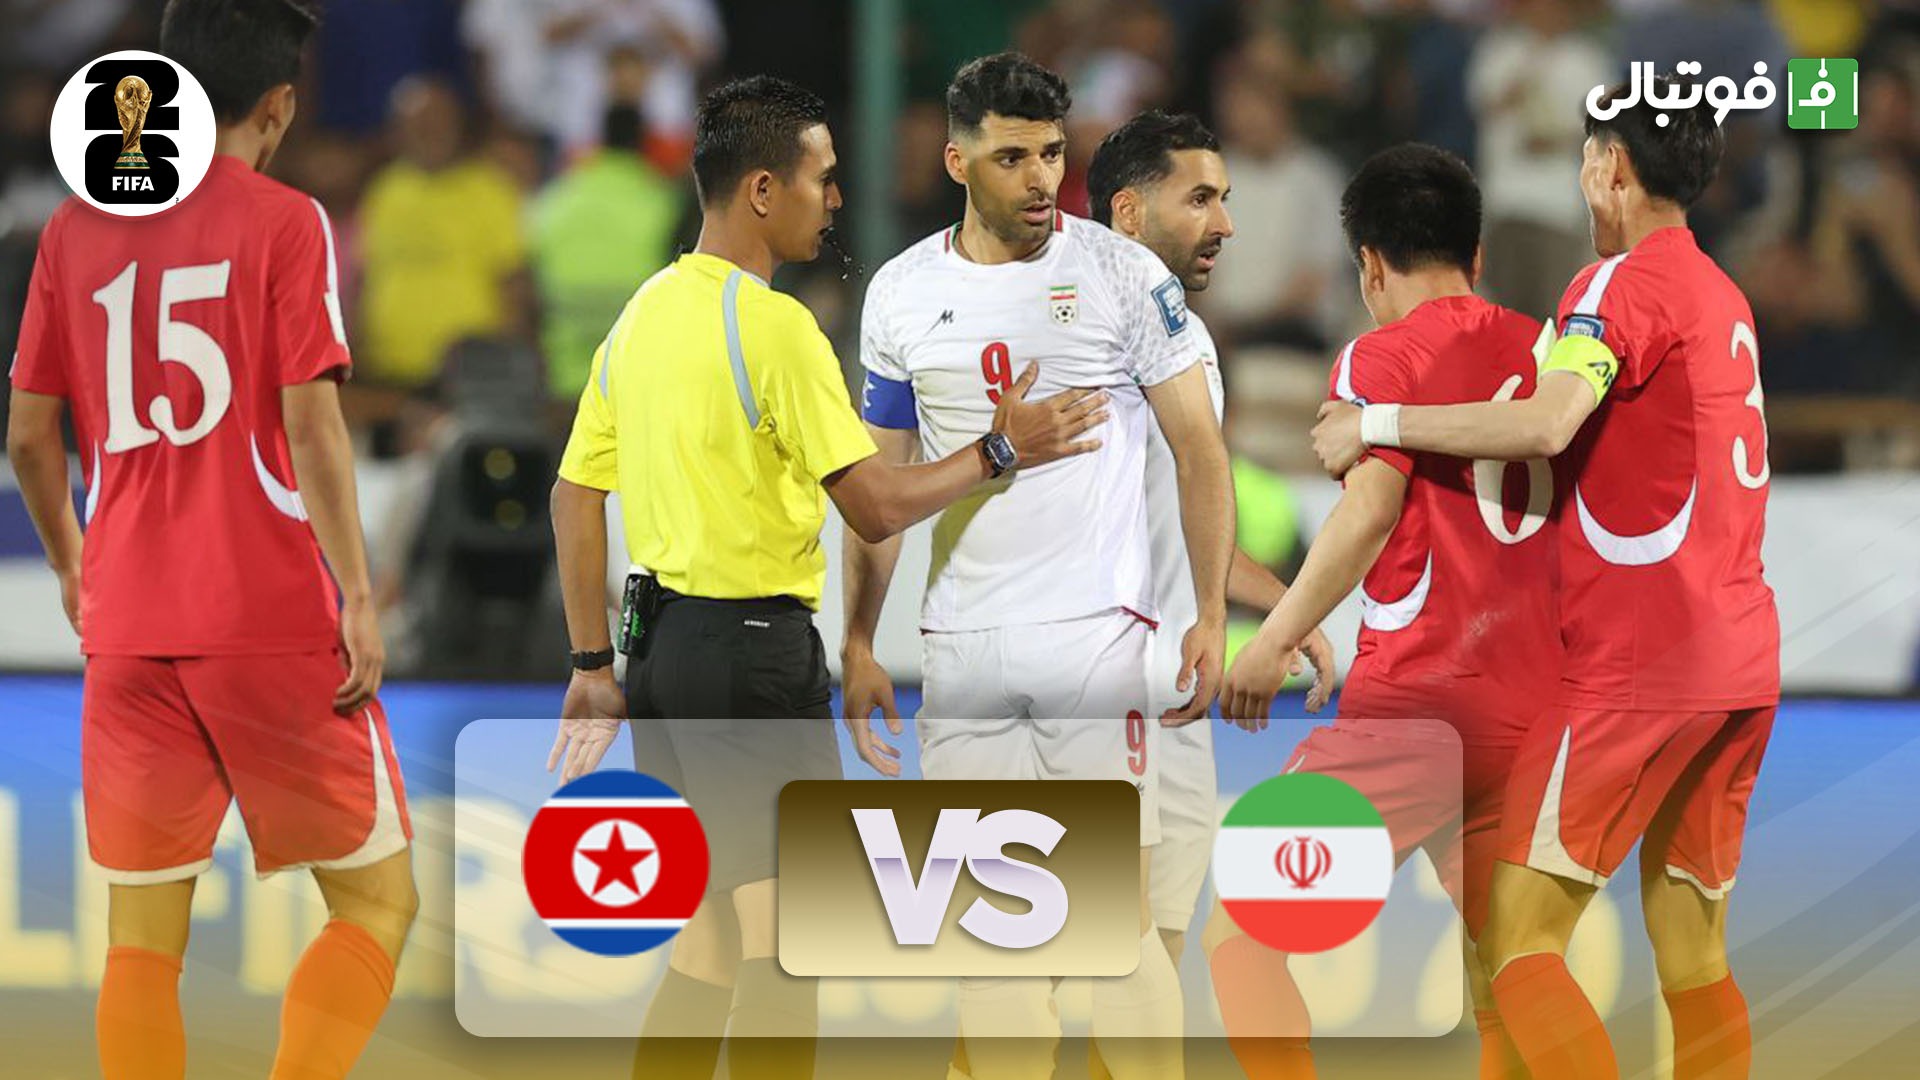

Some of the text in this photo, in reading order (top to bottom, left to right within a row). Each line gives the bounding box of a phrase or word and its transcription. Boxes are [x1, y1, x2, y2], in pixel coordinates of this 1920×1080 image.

[93, 259, 232, 454] 15
[981, 342, 1013, 407] 9
[1731, 321, 1771, 490] 3
[1473, 374, 1554, 544] 6
[1126, 709, 1147, 776] 9
